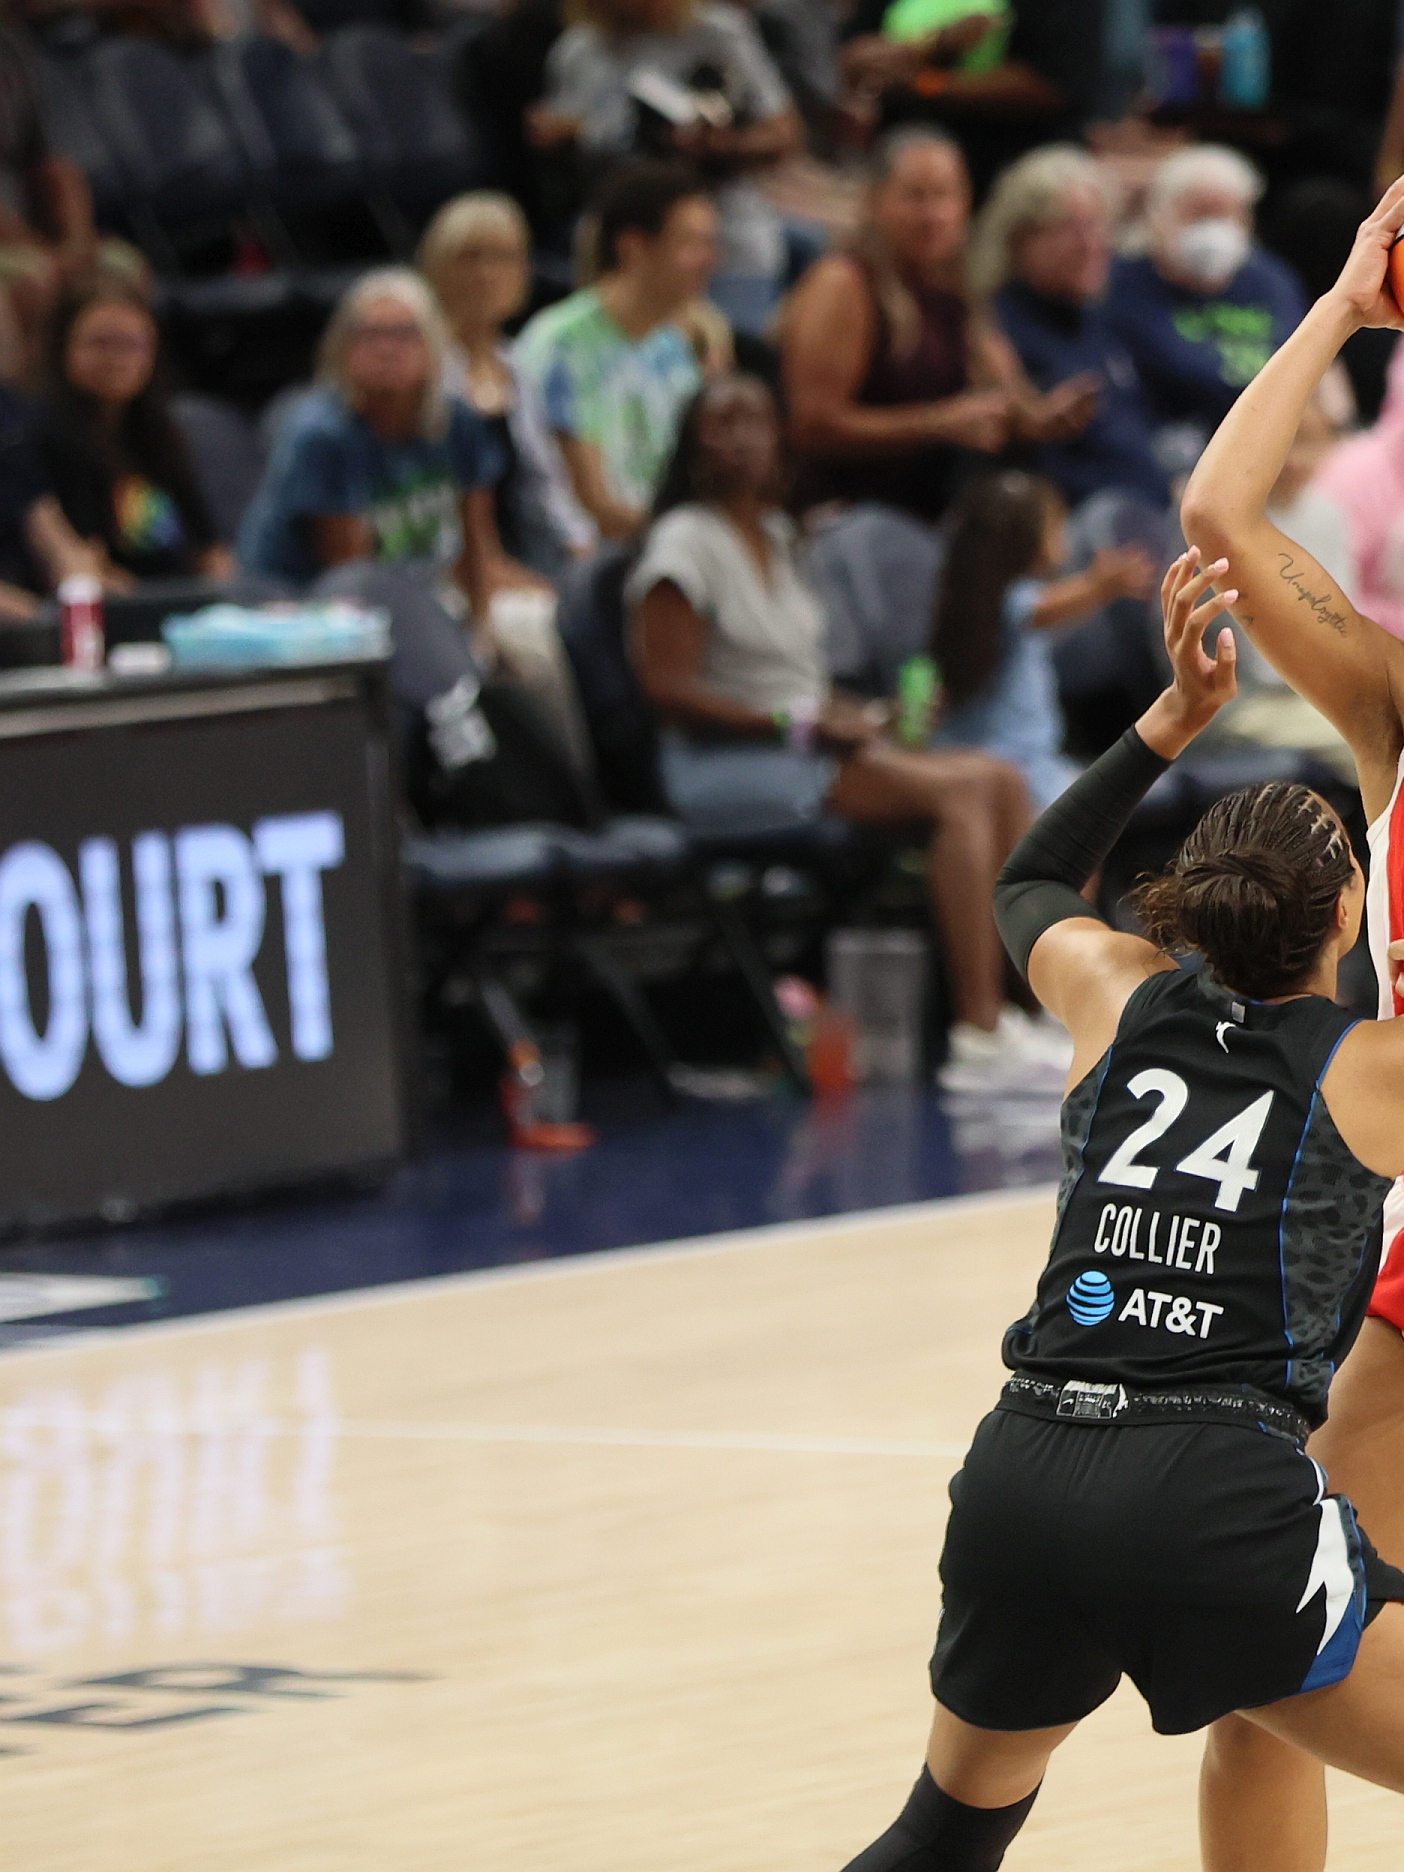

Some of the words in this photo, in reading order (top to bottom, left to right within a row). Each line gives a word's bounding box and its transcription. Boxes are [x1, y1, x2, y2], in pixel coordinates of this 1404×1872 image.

[1097, 1067, 1276, 1214] 24
[1094, 1202, 1223, 1275] COLLIER
[1117, 1287, 1225, 1340] AT&T
